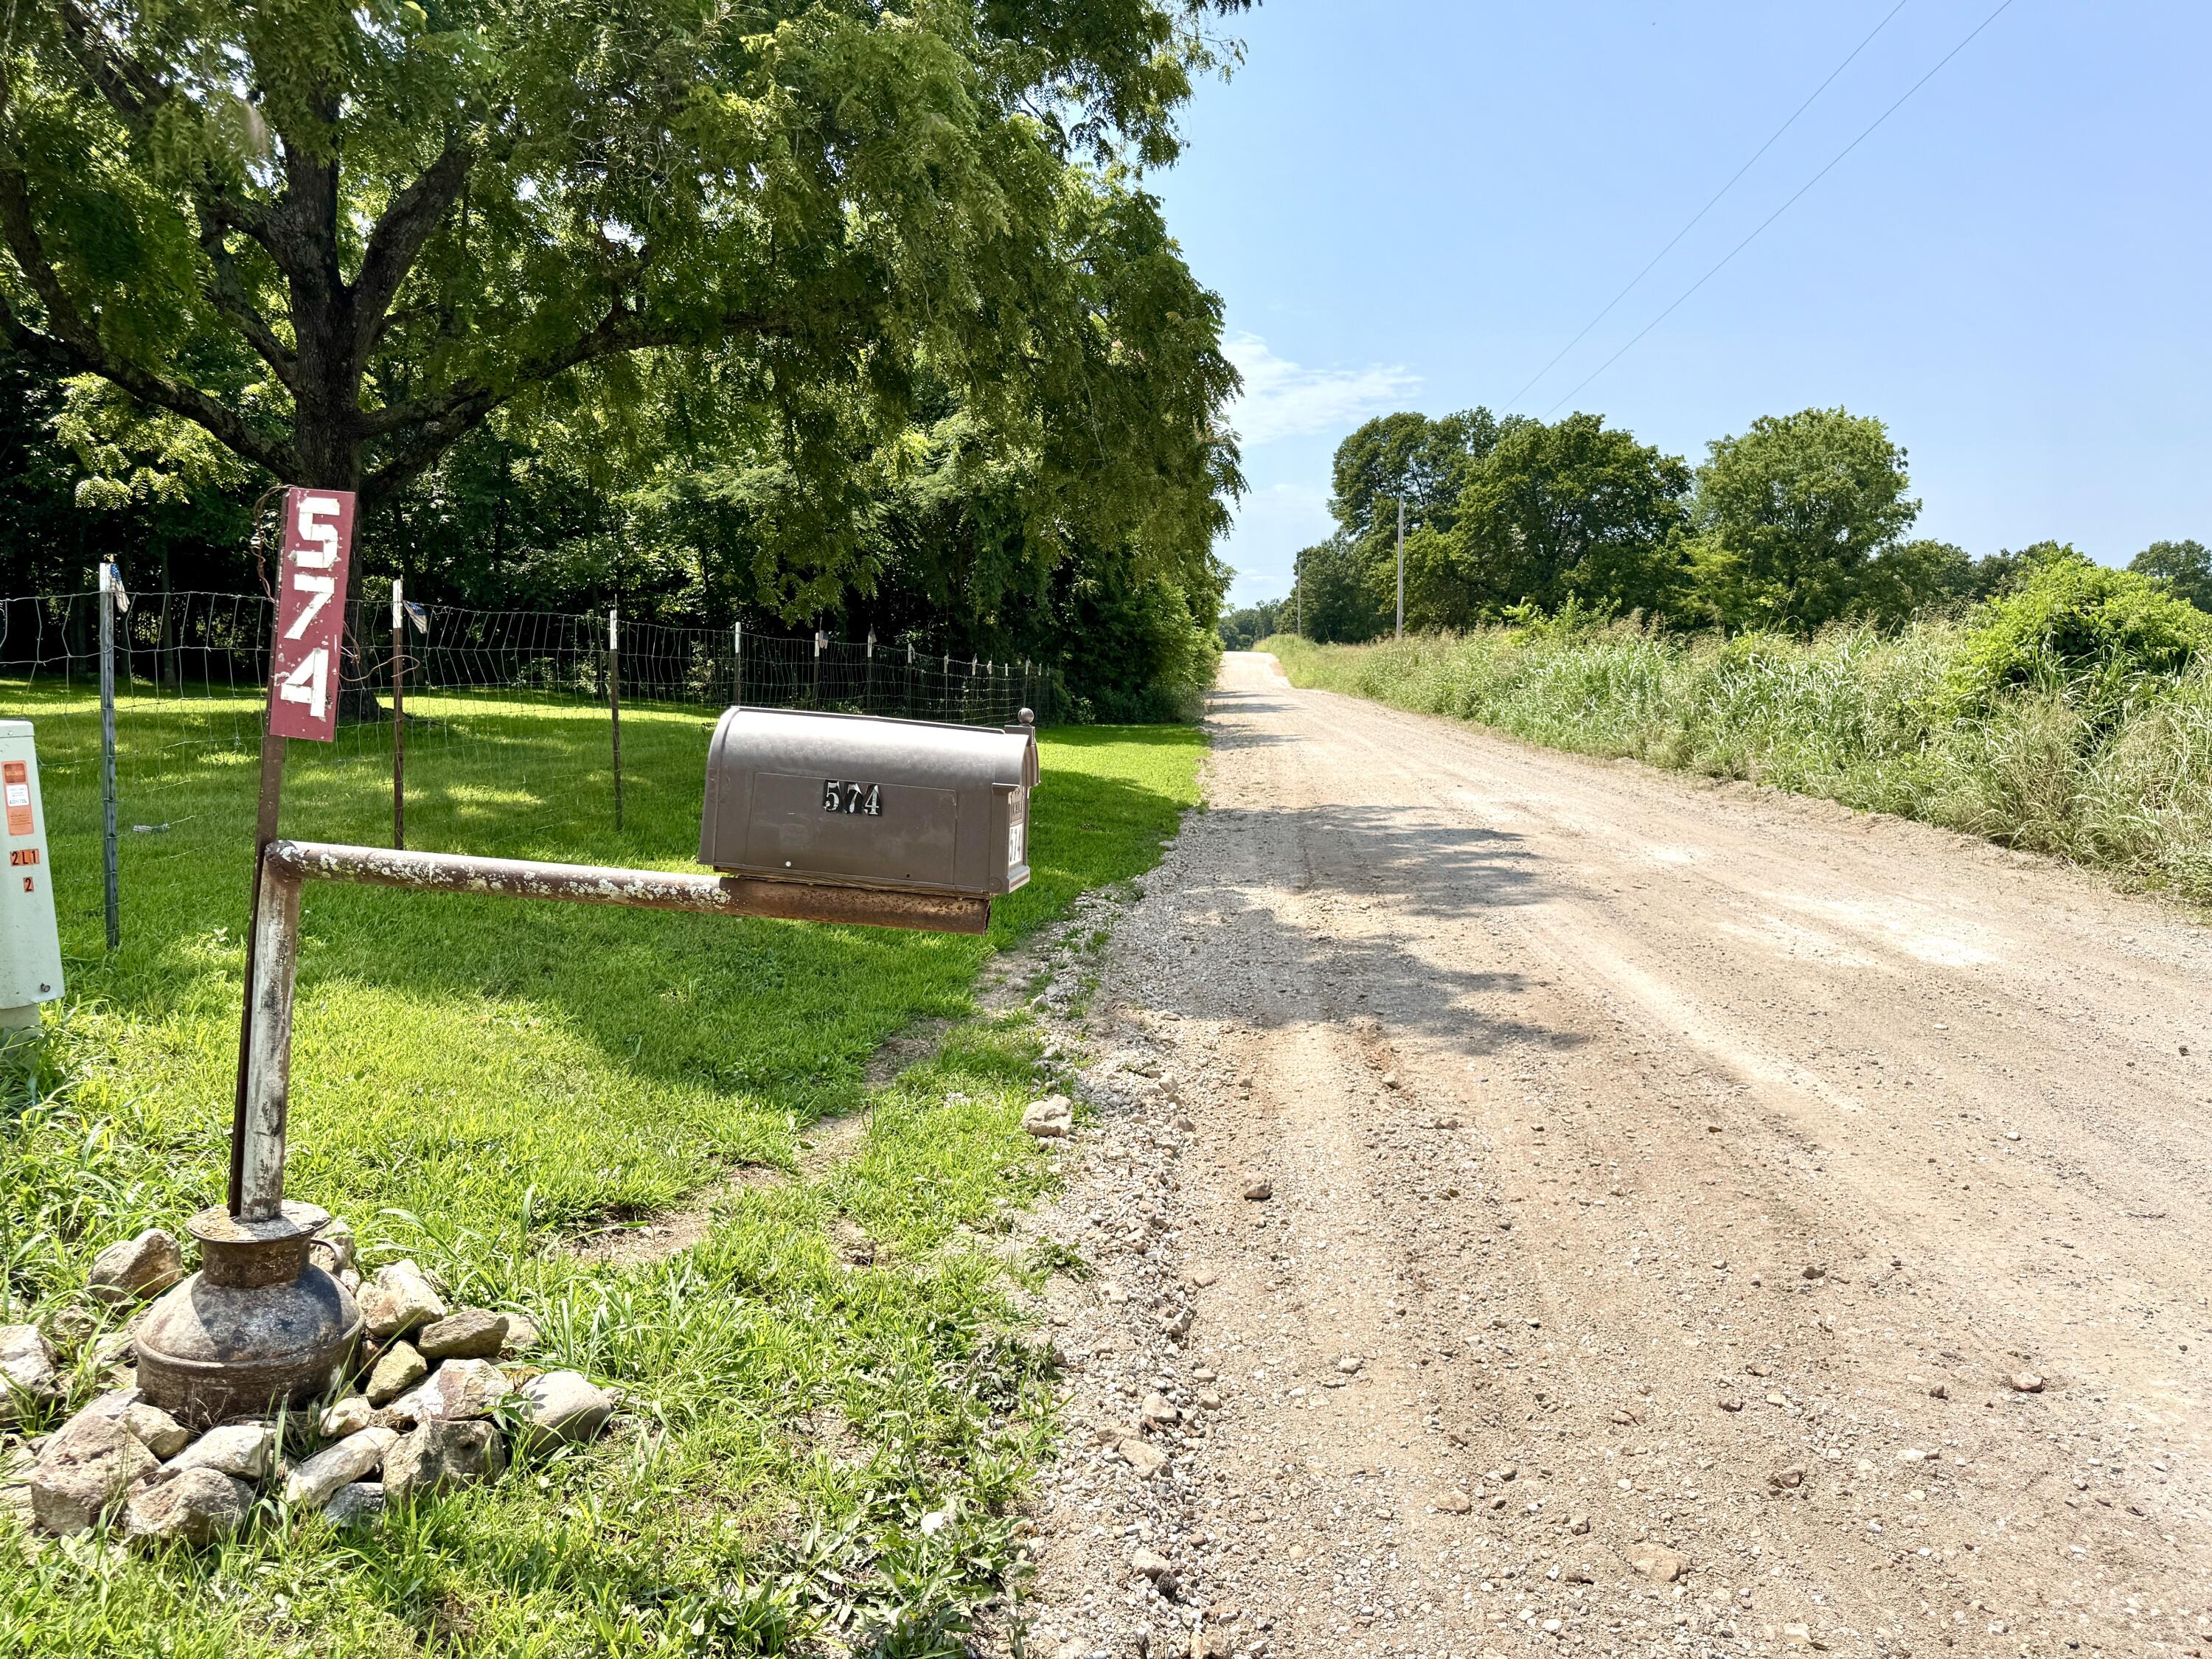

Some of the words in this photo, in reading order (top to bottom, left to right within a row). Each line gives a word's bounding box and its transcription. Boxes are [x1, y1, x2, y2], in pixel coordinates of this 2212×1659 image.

[280, 497, 340, 717] 574
[825, 782, 880, 815] 574
[12, 850, 36, 865] 2L1
[1009, 827, 1021, 862] 574
[25, 878, 32, 891] 2
